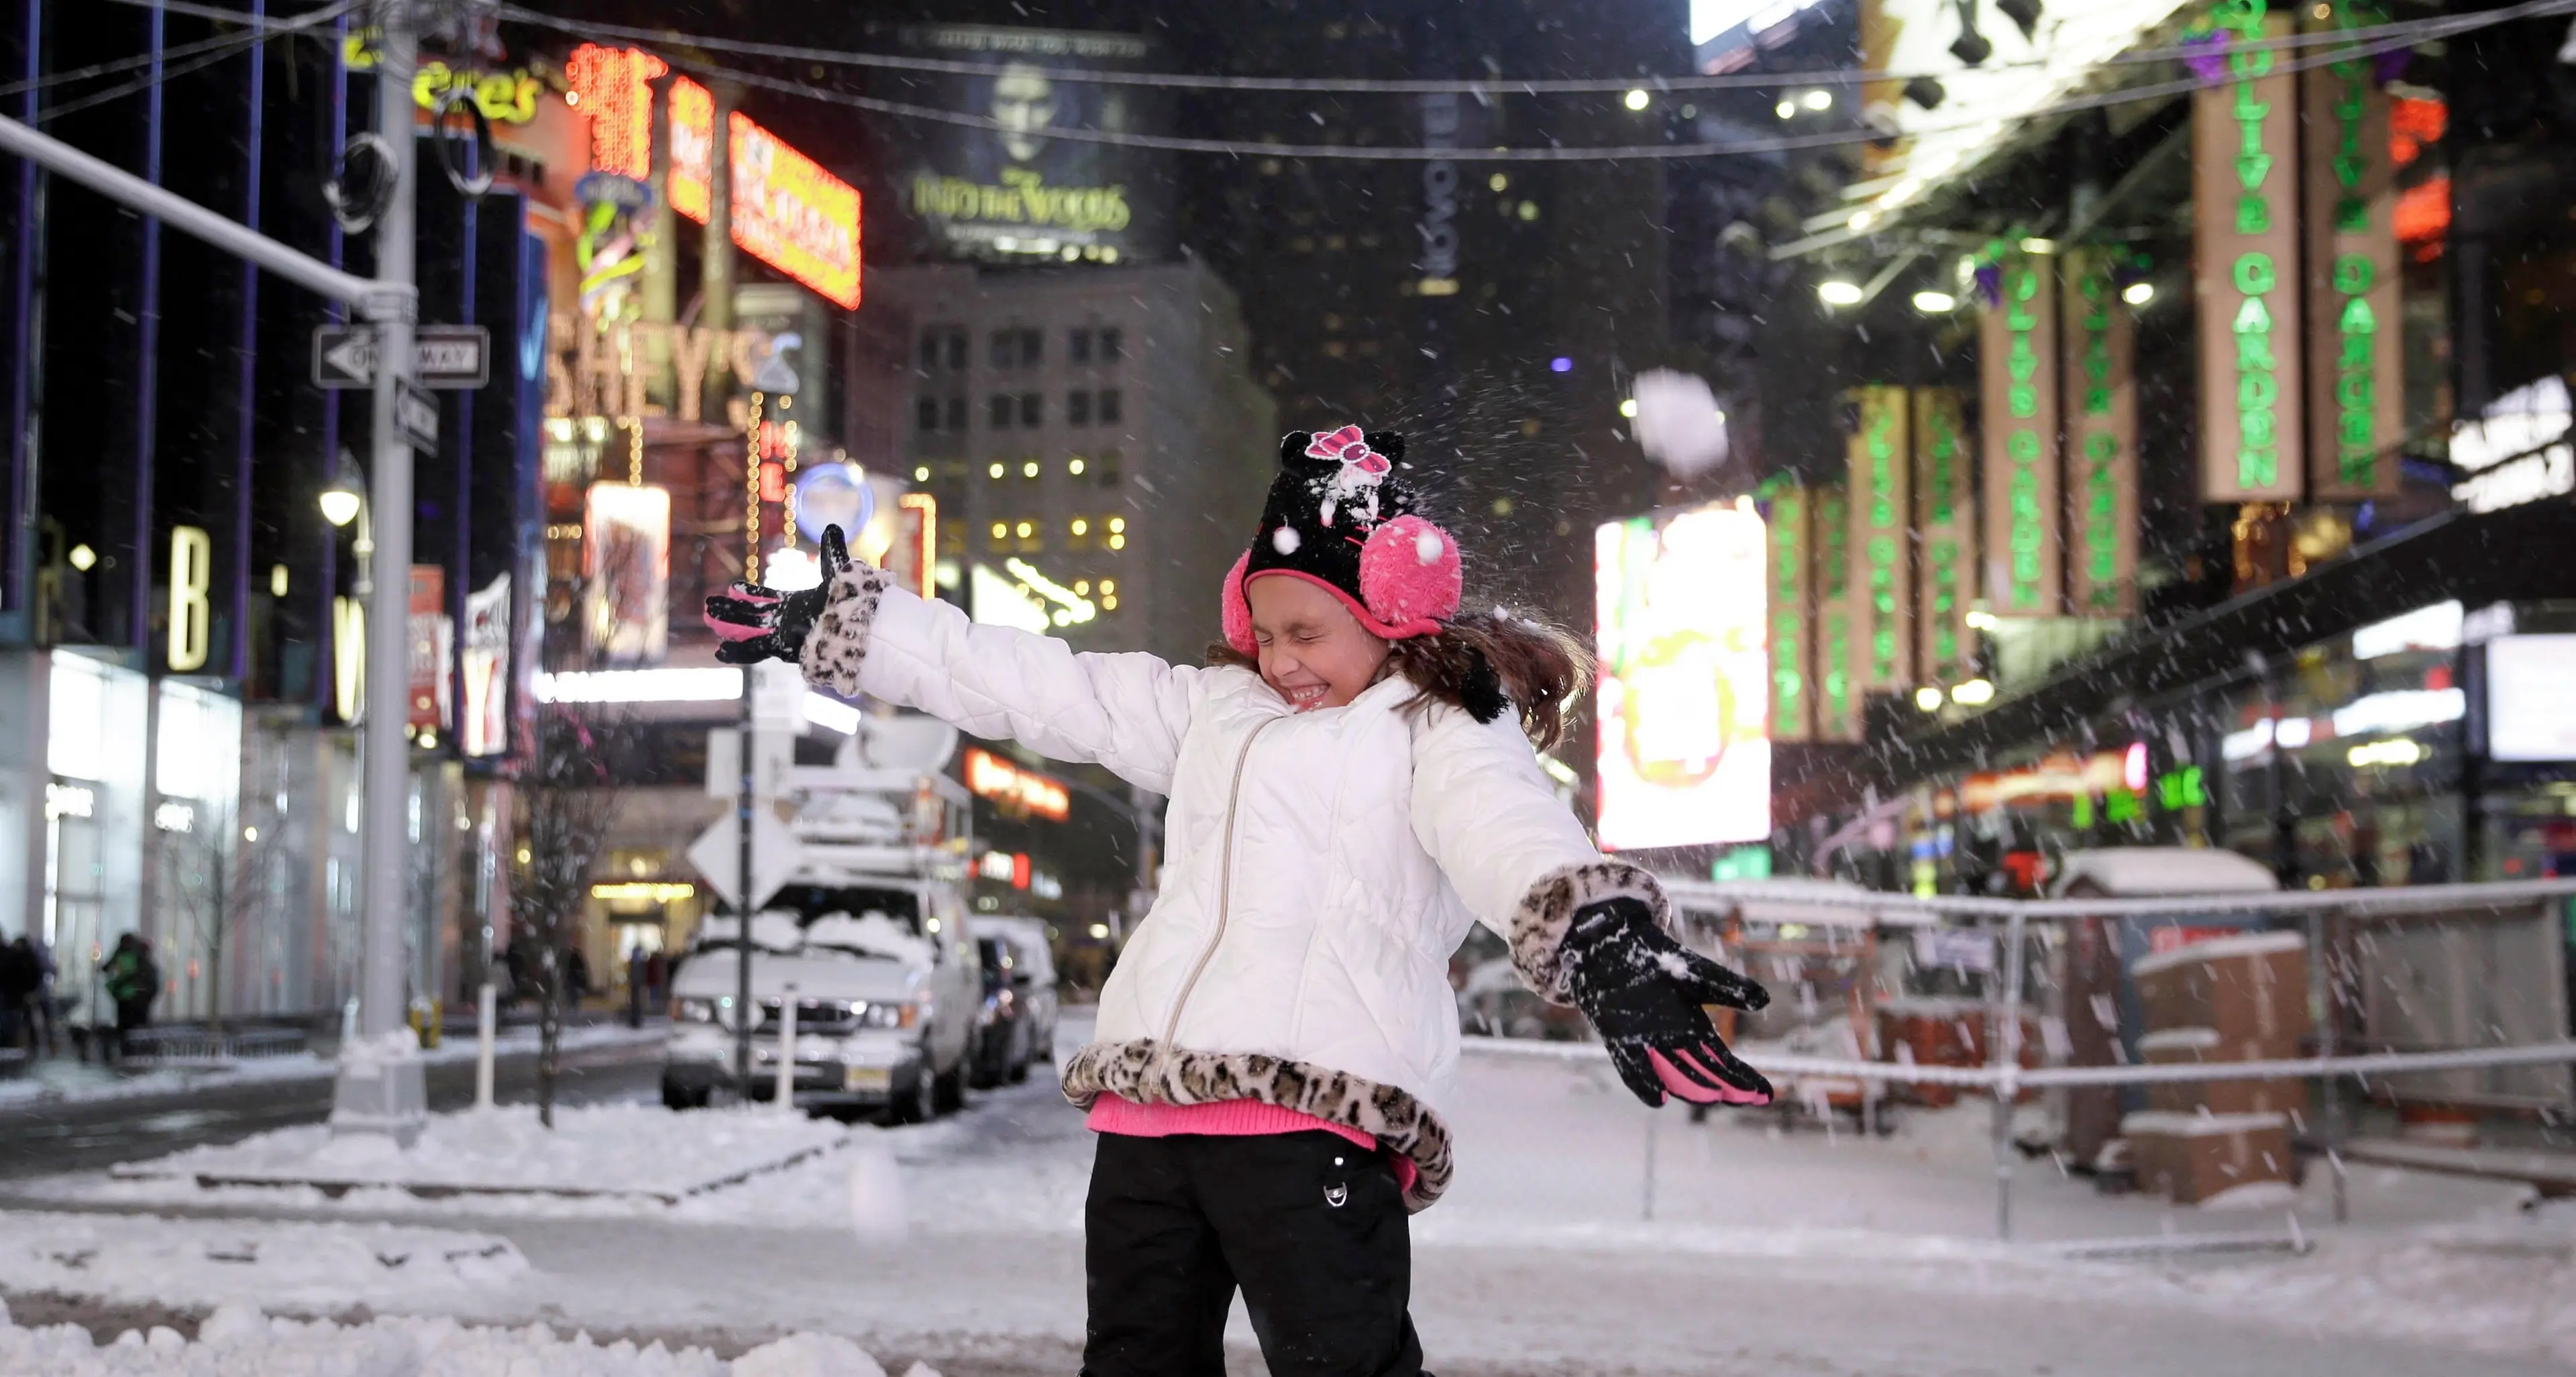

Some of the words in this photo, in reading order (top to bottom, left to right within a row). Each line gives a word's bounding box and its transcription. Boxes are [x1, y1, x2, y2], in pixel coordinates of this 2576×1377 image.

[2231, 44, 2273, 233] OLIVE
[421, 345, 468, 364] WAY
[2231, 252, 2277, 489] GARDEN
